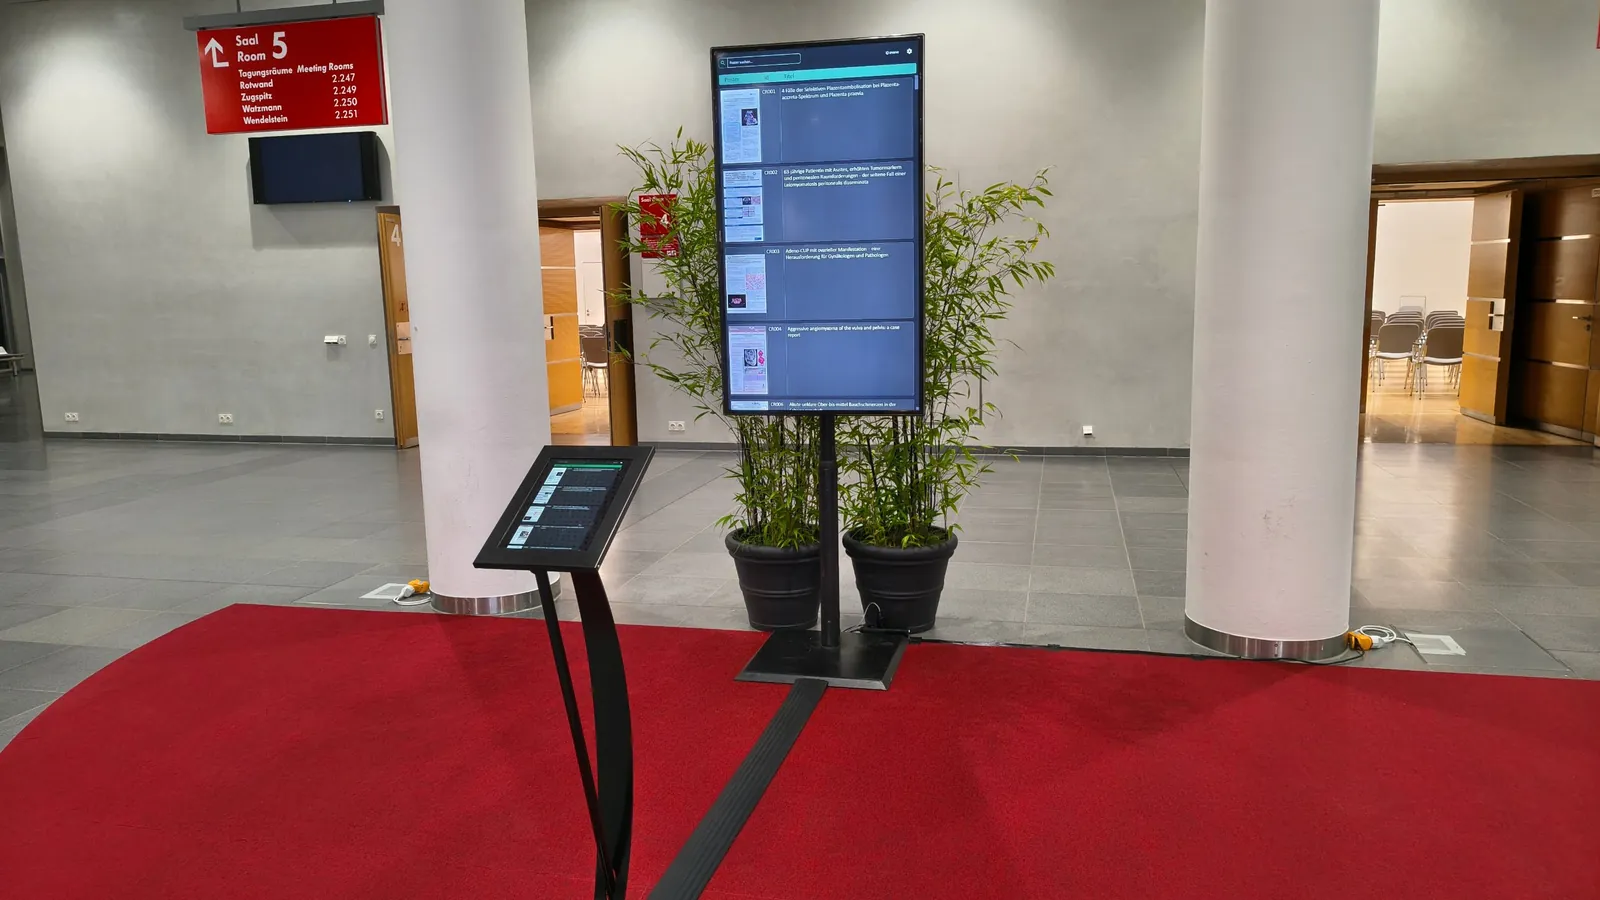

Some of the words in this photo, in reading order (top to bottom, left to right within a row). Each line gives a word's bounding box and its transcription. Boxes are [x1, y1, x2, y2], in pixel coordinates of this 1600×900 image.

[236, 33, 258, 46] Saal
[273, 31, 287, 59] 5
[237, 51, 265, 62] Room
[239, 68, 292, 79] Tagungsräume
[297, 64, 326, 73] Meeting
[329, 63, 353, 71] Rooms
[240, 79, 273, 89] Rotwand
[332, 73, 355, 83] 2.247
[241, 92, 272, 102] Zugspitz
[333, 86, 356, 95] 2.249
[242, 105, 282, 113] Watzmann
[334, 97, 357, 107] 2.250
[243, 115, 288, 124] Wendelstein
[335, 109, 357, 119] 2.251
